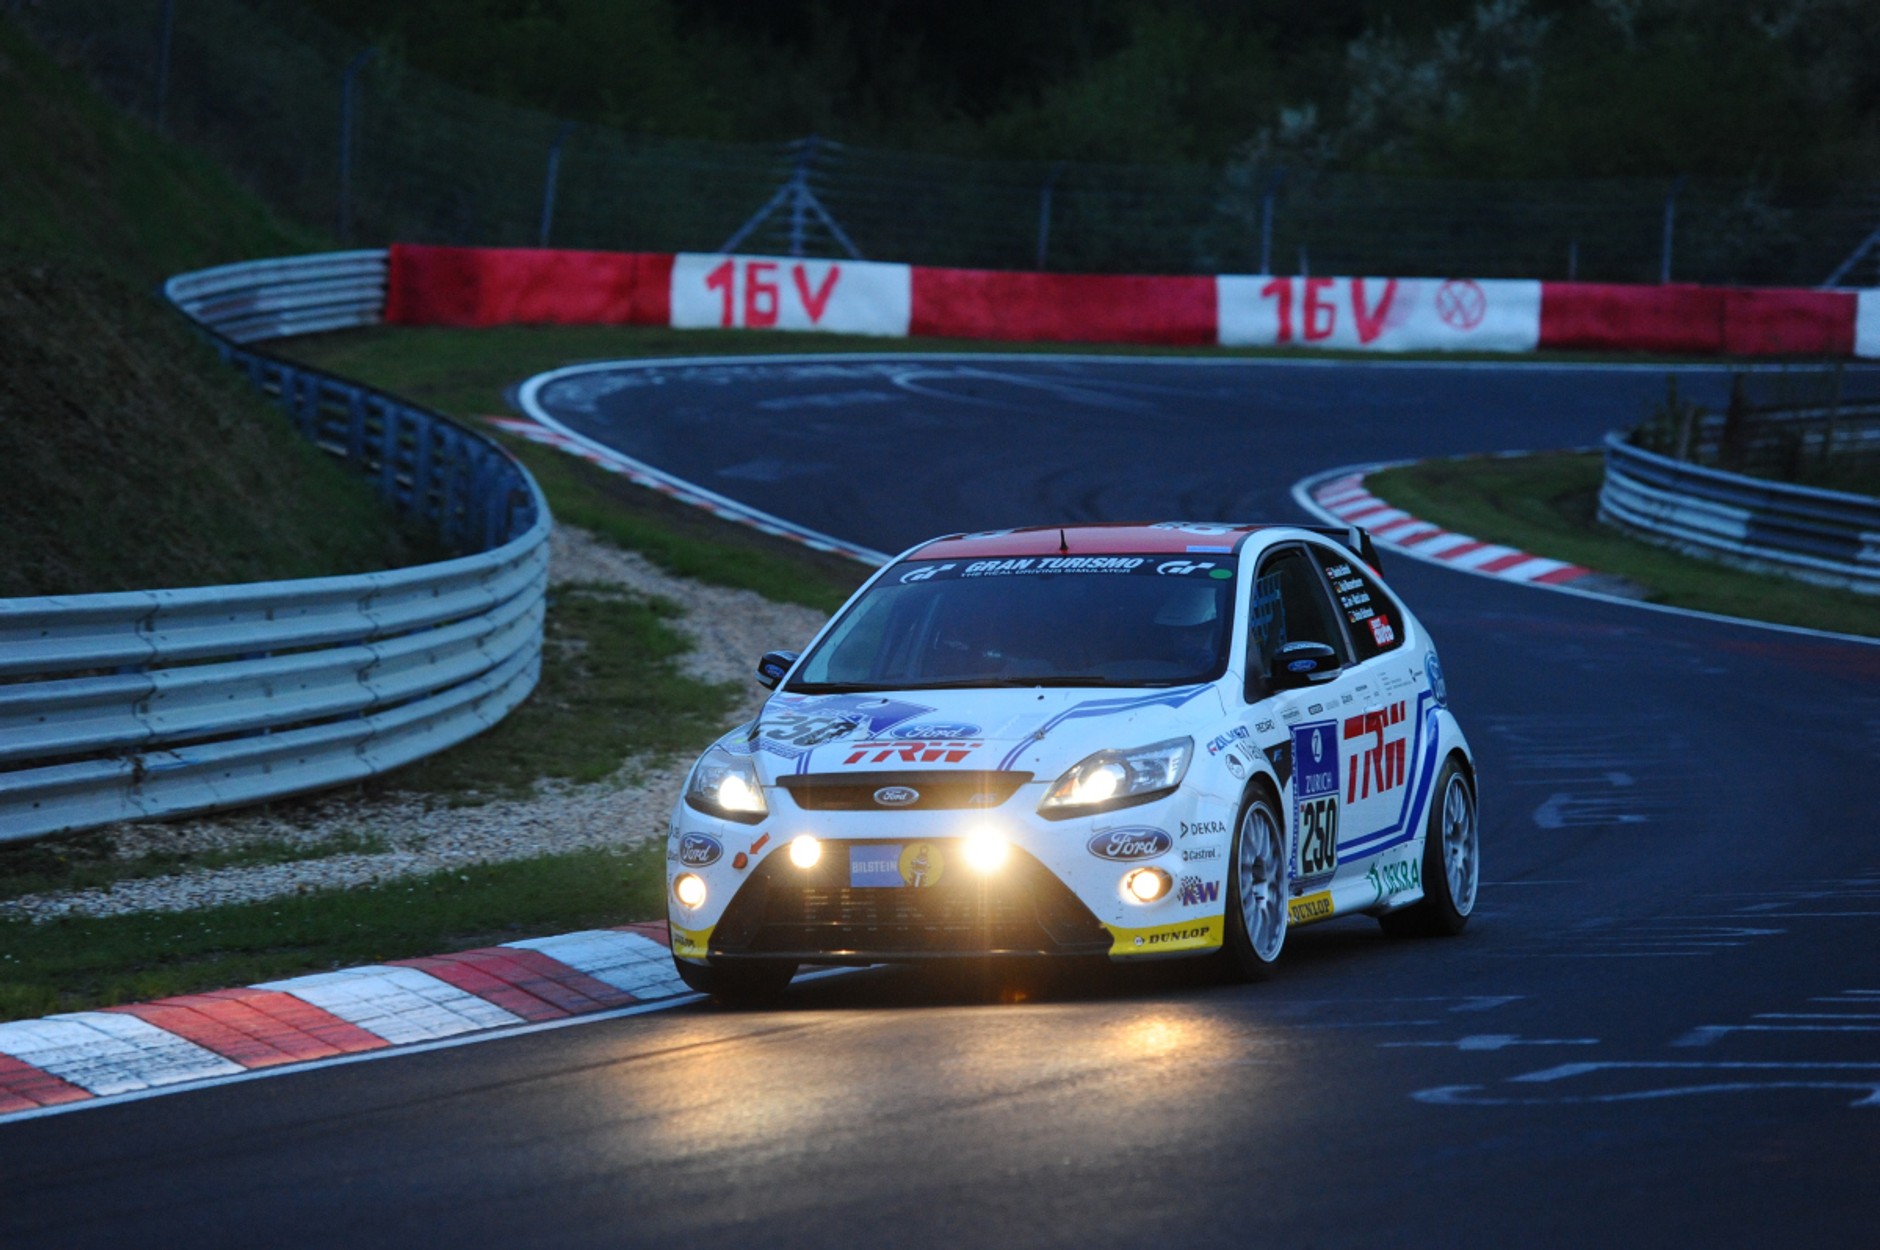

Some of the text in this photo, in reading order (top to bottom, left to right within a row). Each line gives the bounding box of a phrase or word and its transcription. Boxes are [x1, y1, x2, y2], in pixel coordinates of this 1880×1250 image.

[705, 256, 841, 328] 16V
[1261, 276, 1397, 344] 16V
[965, 557, 1144, 573] GRAN TURISMO
[906, 725, 965, 738] Ford
[1206, 725, 1250, 757] FALKEN
[843, 742, 984, 765] TRW
[1344, 700, 1405, 805] TRW
[1305, 773, 1333, 794] ZURICH
[1190, 821, 1226, 836] DEKRA
[1302, 798, 1336, 875] 250
[1106, 831, 1158, 857] Ford
[1189, 849, 1216, 861] Castrol
[852, 861, 898, 873] BILSTEIN
[1382, 858, 1421, 896] DEKRA
[1290, 898, 1331, 921] DUNLOP
[1148, 927, 1210, 945] DUNLOP
